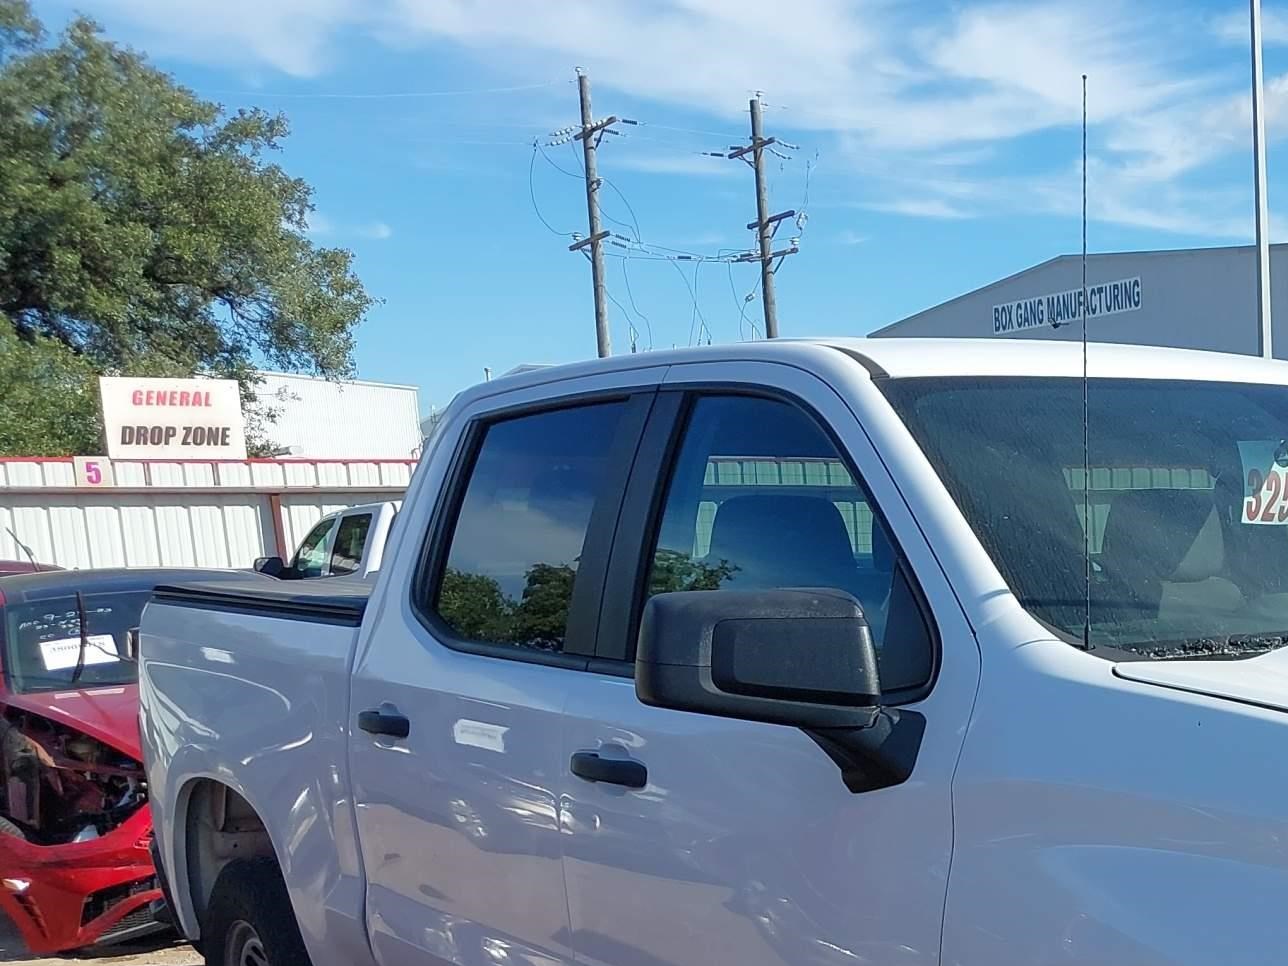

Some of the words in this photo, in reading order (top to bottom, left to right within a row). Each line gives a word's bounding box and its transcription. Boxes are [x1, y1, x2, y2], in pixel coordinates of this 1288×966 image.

[994, 304, 1014, 332] BOX
[1015, 298, 1044, 328] GANG
[1046, 279, 1141, 323] MANUFACTURING
[132, 390, 212, 407] GENERAL
[120, 424, 177, 446] DROP
[181, 426, 231, 447] ZONE
[85, 461, 102, 485] 5
